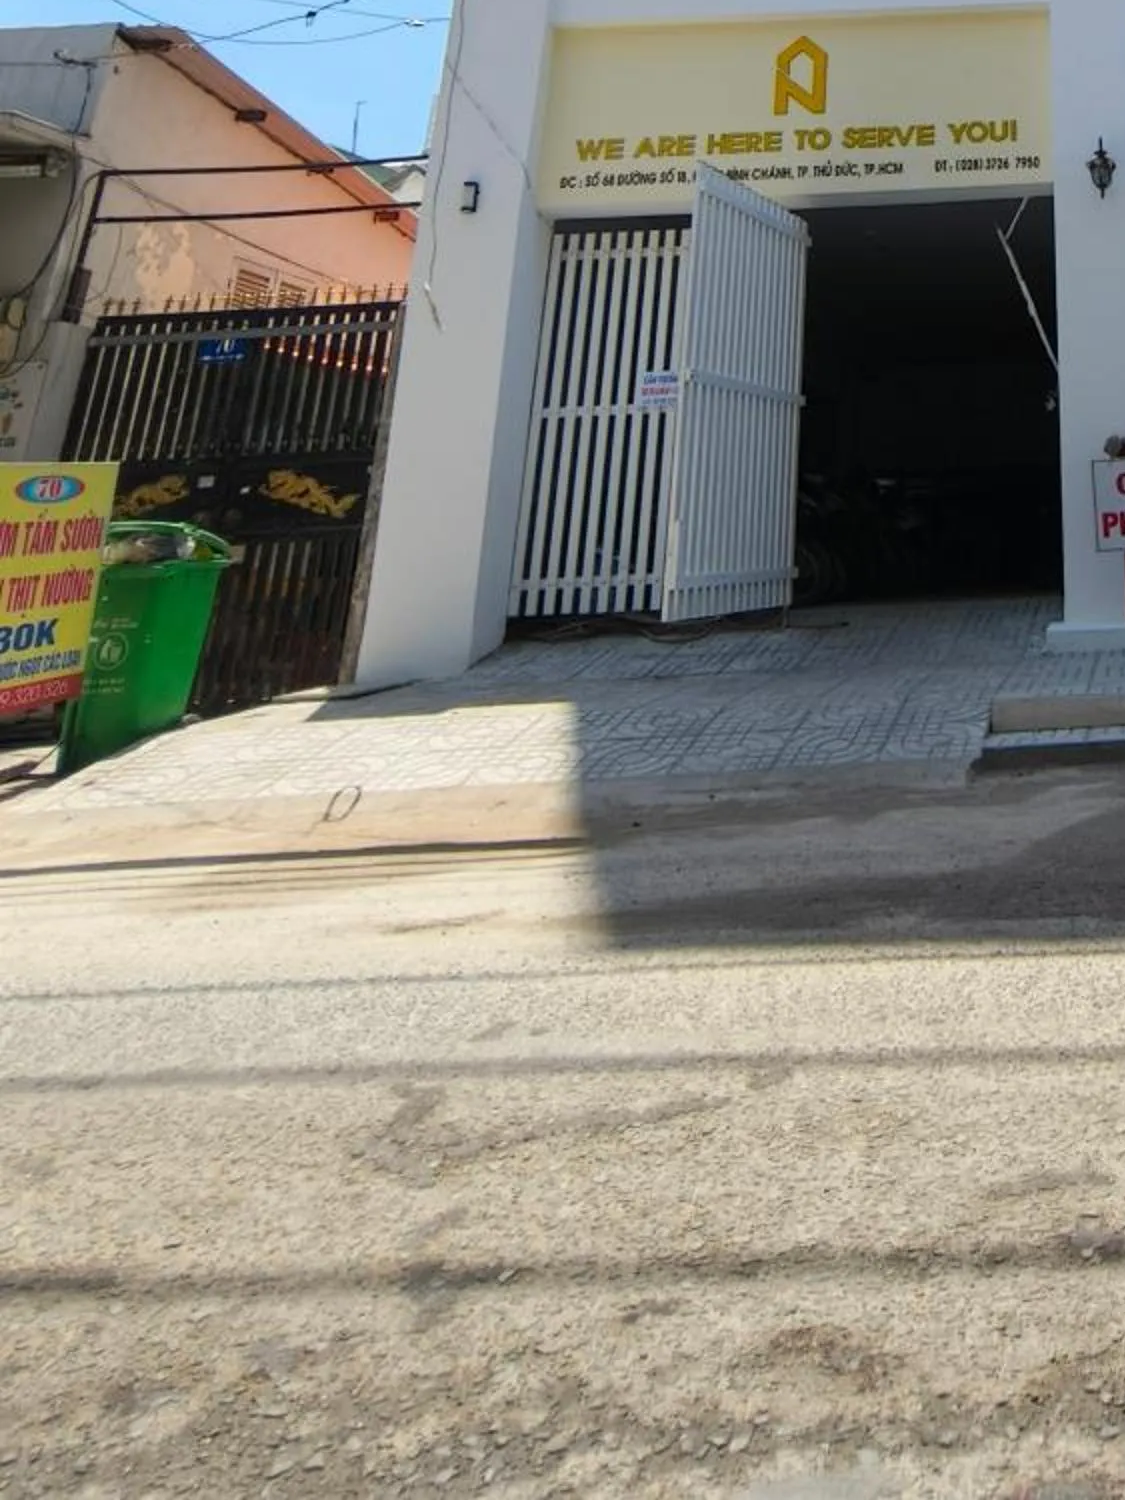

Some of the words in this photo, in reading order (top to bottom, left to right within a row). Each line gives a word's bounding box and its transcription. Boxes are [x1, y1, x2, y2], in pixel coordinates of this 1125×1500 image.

[576, 137, 625, 161] WE
[633, 134, 697, 158] ARE
[706, 130, 783, 155] HERE
[794, 127, 832, 150] TO
[842, 124, 935, 150] SERVE
[39, 478, 62, 498] 70
